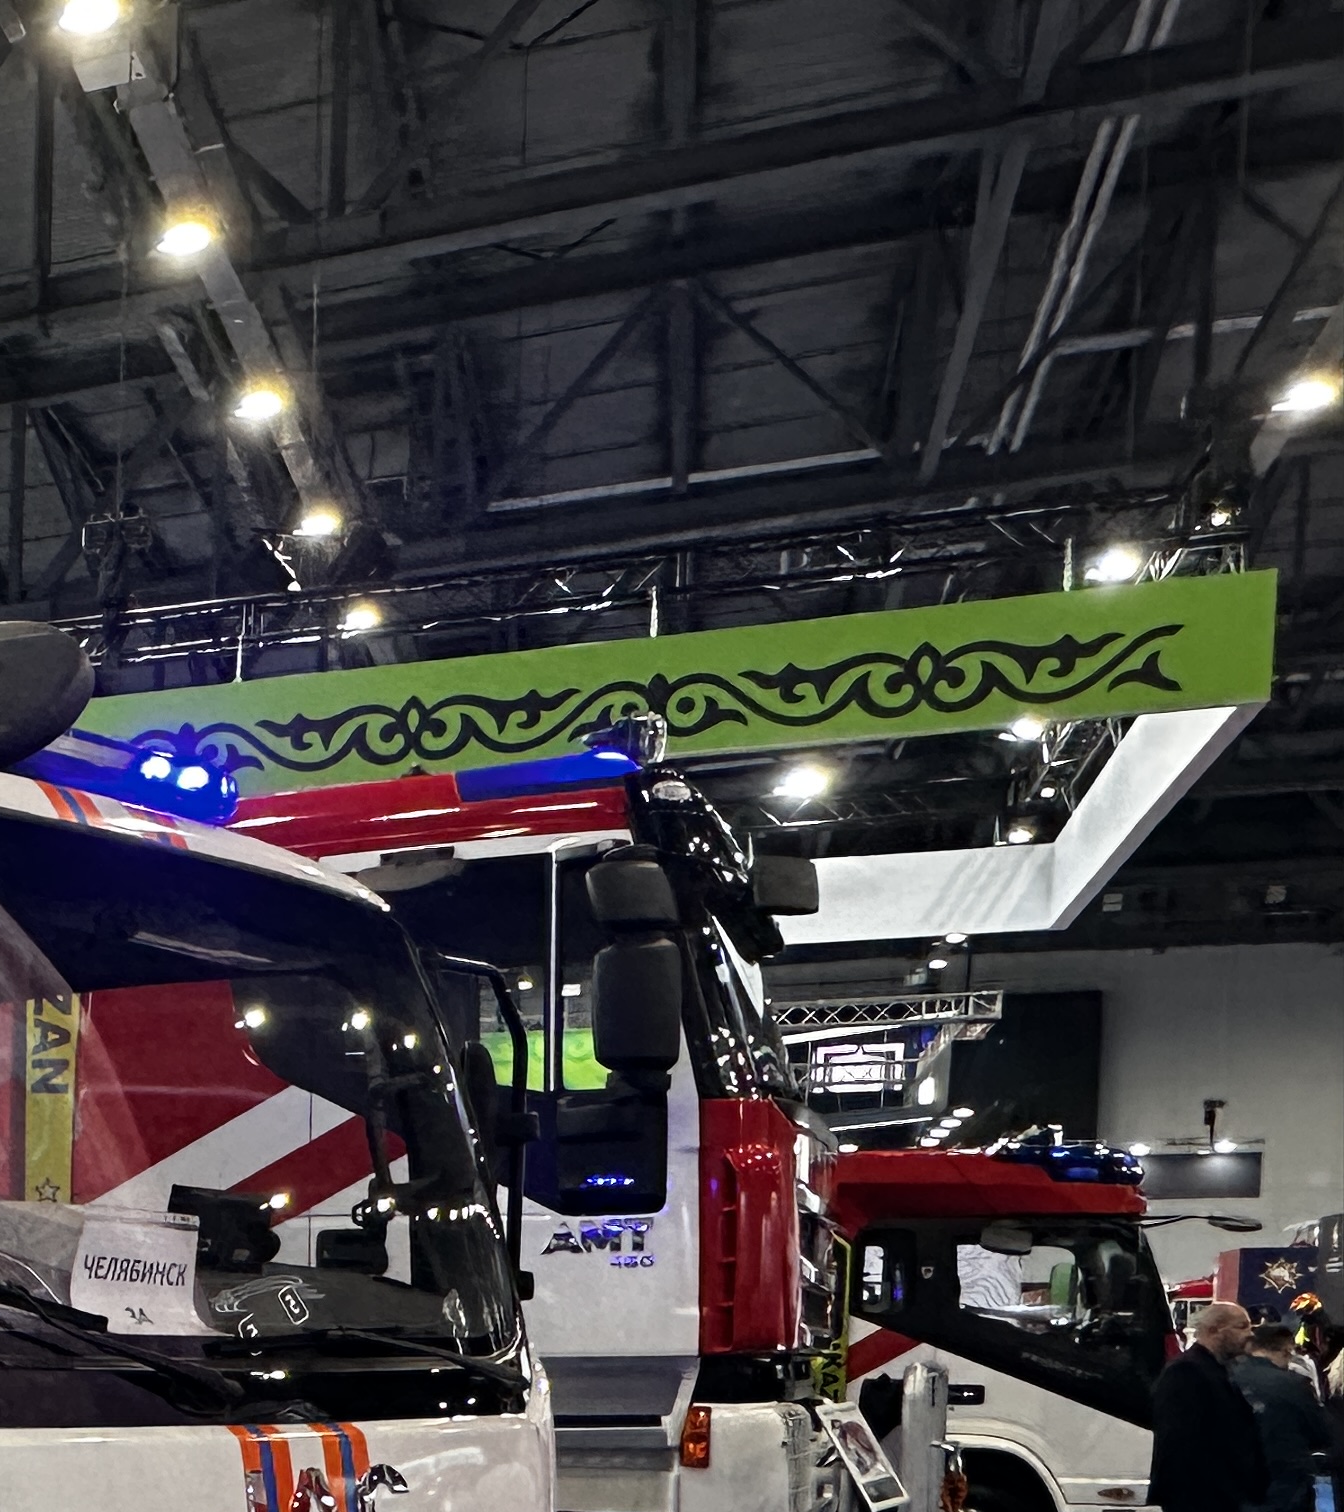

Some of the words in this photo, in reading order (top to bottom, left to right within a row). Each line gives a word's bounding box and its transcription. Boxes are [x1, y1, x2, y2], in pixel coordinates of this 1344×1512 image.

[31, 993, 72, 1094] ZAN
[540, 1217, 654, 1255] AMT
[83, 1254, 188, 1286] ЧЕЛЯБИНСК
[821, 1352, 842, 1401] KAZ
